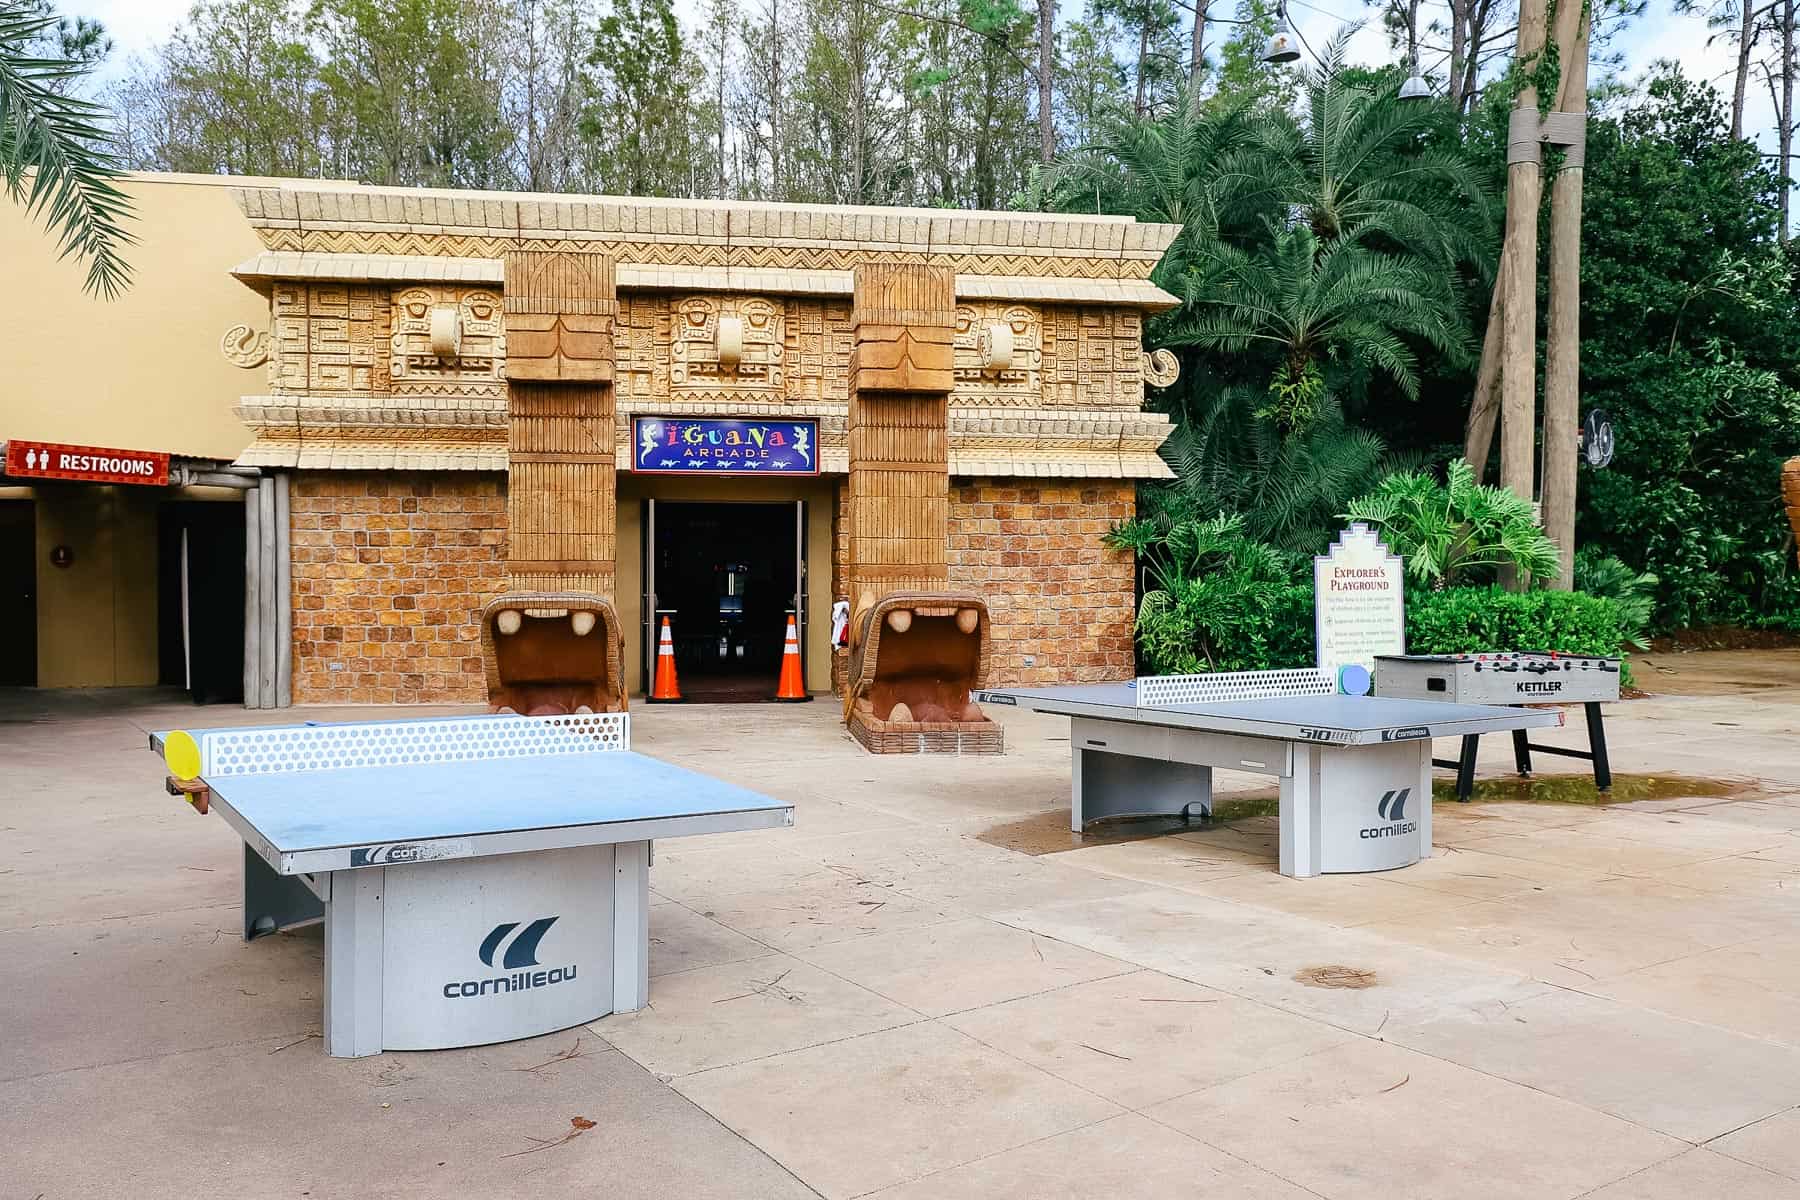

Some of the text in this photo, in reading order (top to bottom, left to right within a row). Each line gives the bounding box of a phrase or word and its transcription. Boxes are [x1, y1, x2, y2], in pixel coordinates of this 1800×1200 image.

[59, 454, 154, 475] RESTROOMS
[1516, 681, 1562, 692] KETTLER
[1299, 728, 1331, 740] 510
[1360, 821, 1416, 839] cornilleau
[443, 965, 577, 999] cornilleau
